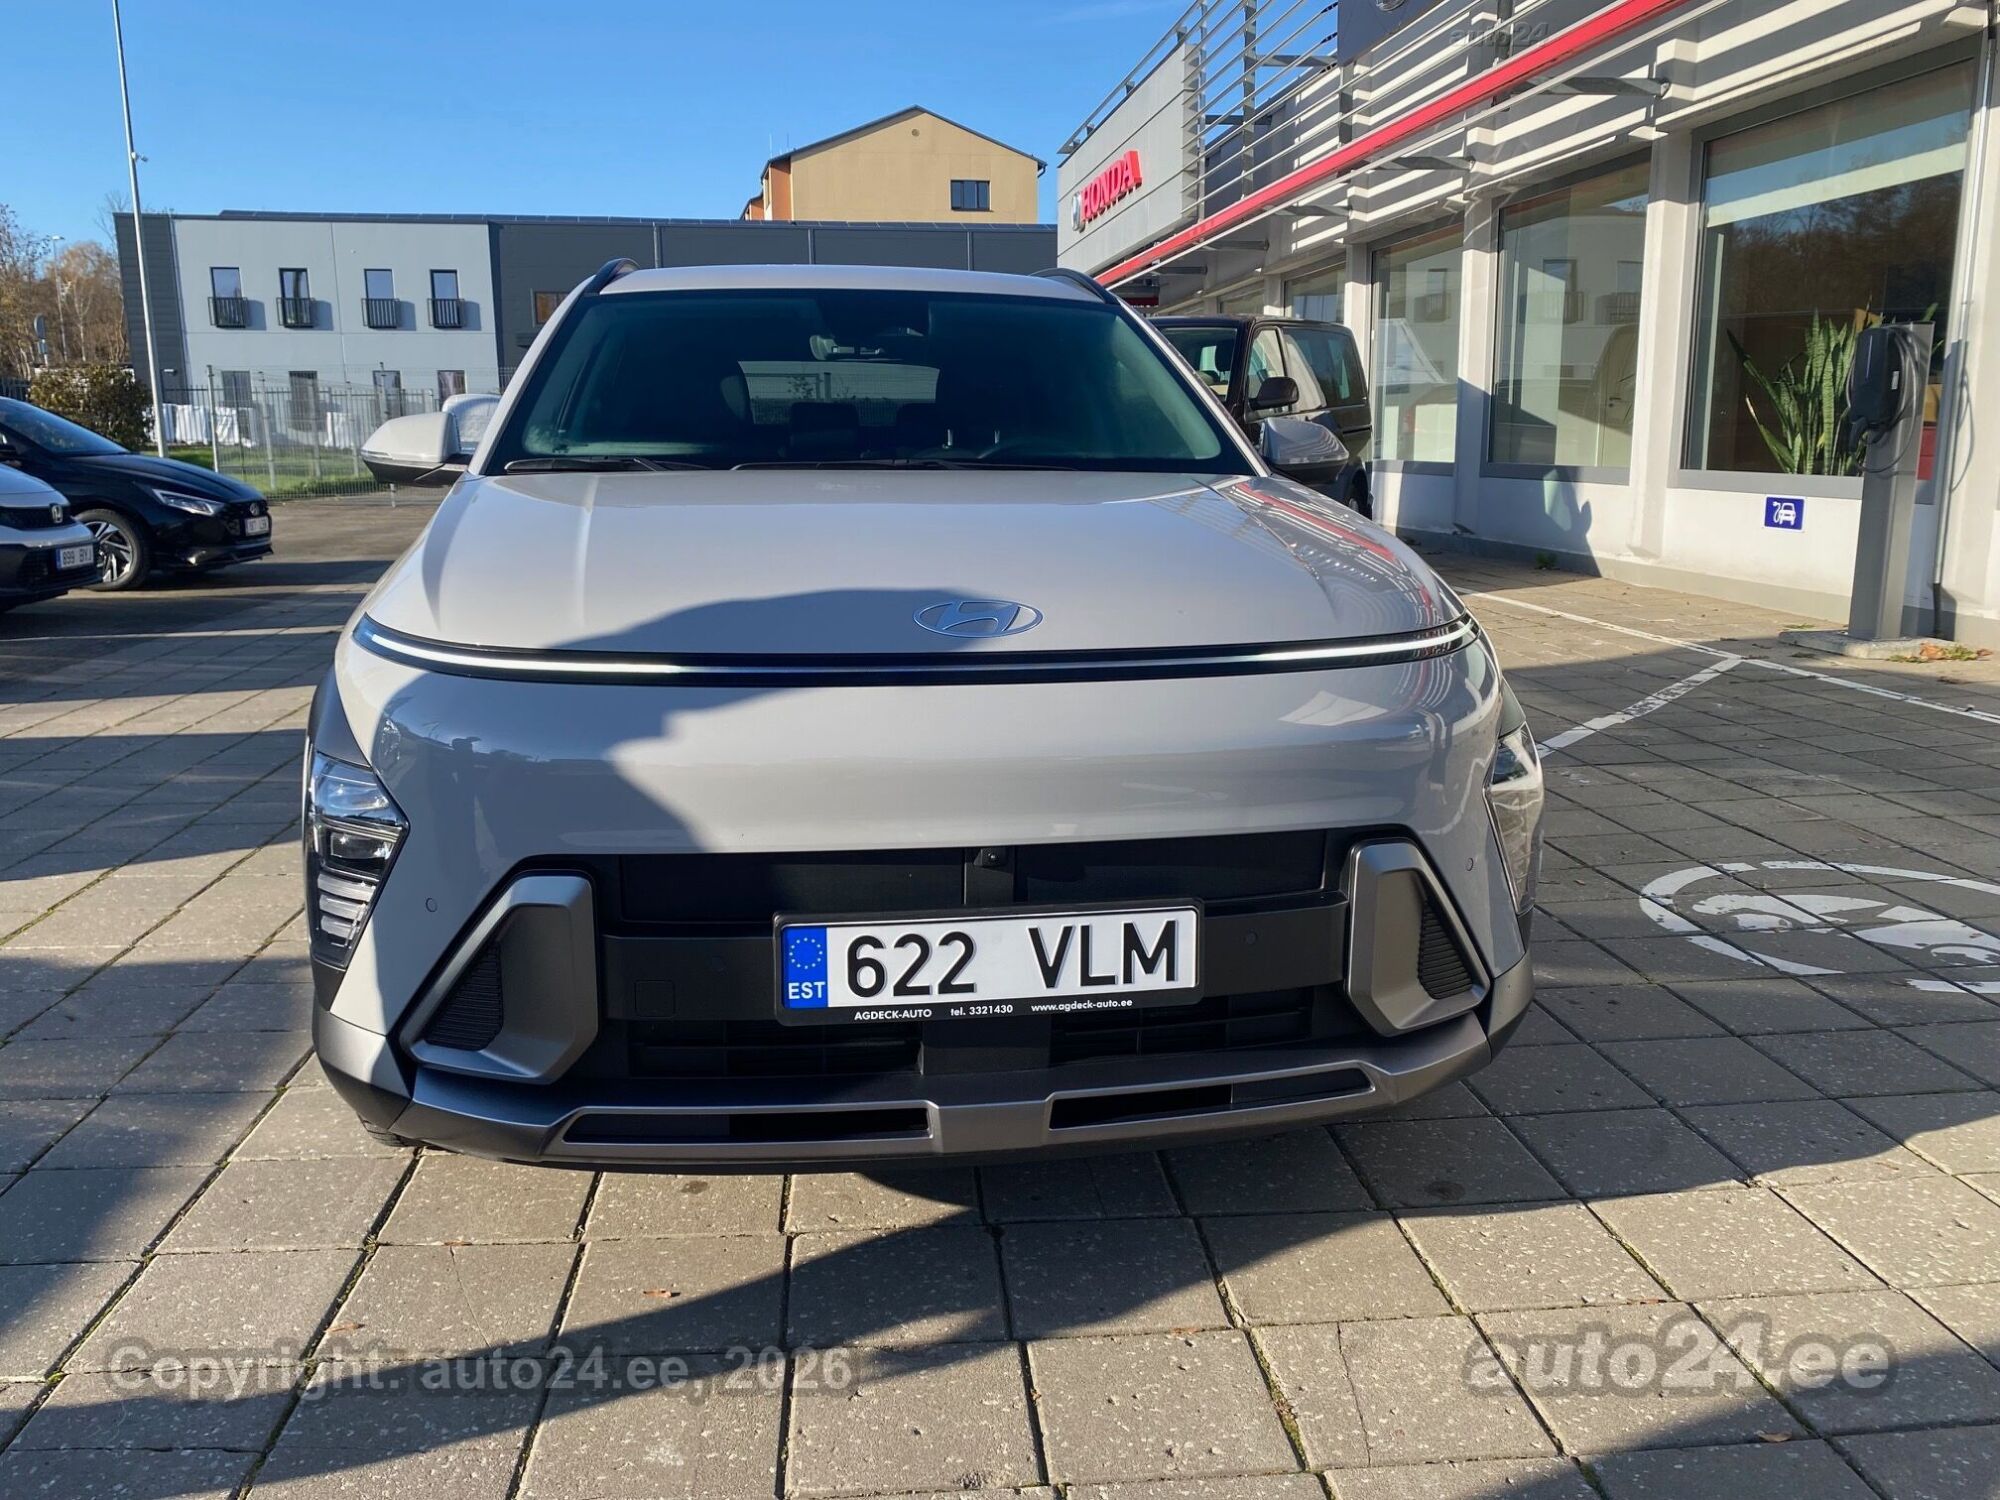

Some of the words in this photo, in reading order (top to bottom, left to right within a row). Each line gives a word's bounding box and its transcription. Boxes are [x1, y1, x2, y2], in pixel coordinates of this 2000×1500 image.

[1080, 150, 1142, 223] HONDA
[846, 930, 976, 998] 622
[1028, 919, 1179, 989] VLM
[788, 981, 826, 1000] EST
[854, 1008, 933, 1021] AGDECK-AUTO
[950, 1007, 966, 1017] tel.
[969, 1004, 1014, 1016] 3321430
[1031, 998, 1133, 1013] www.agdeck-auto.ee
